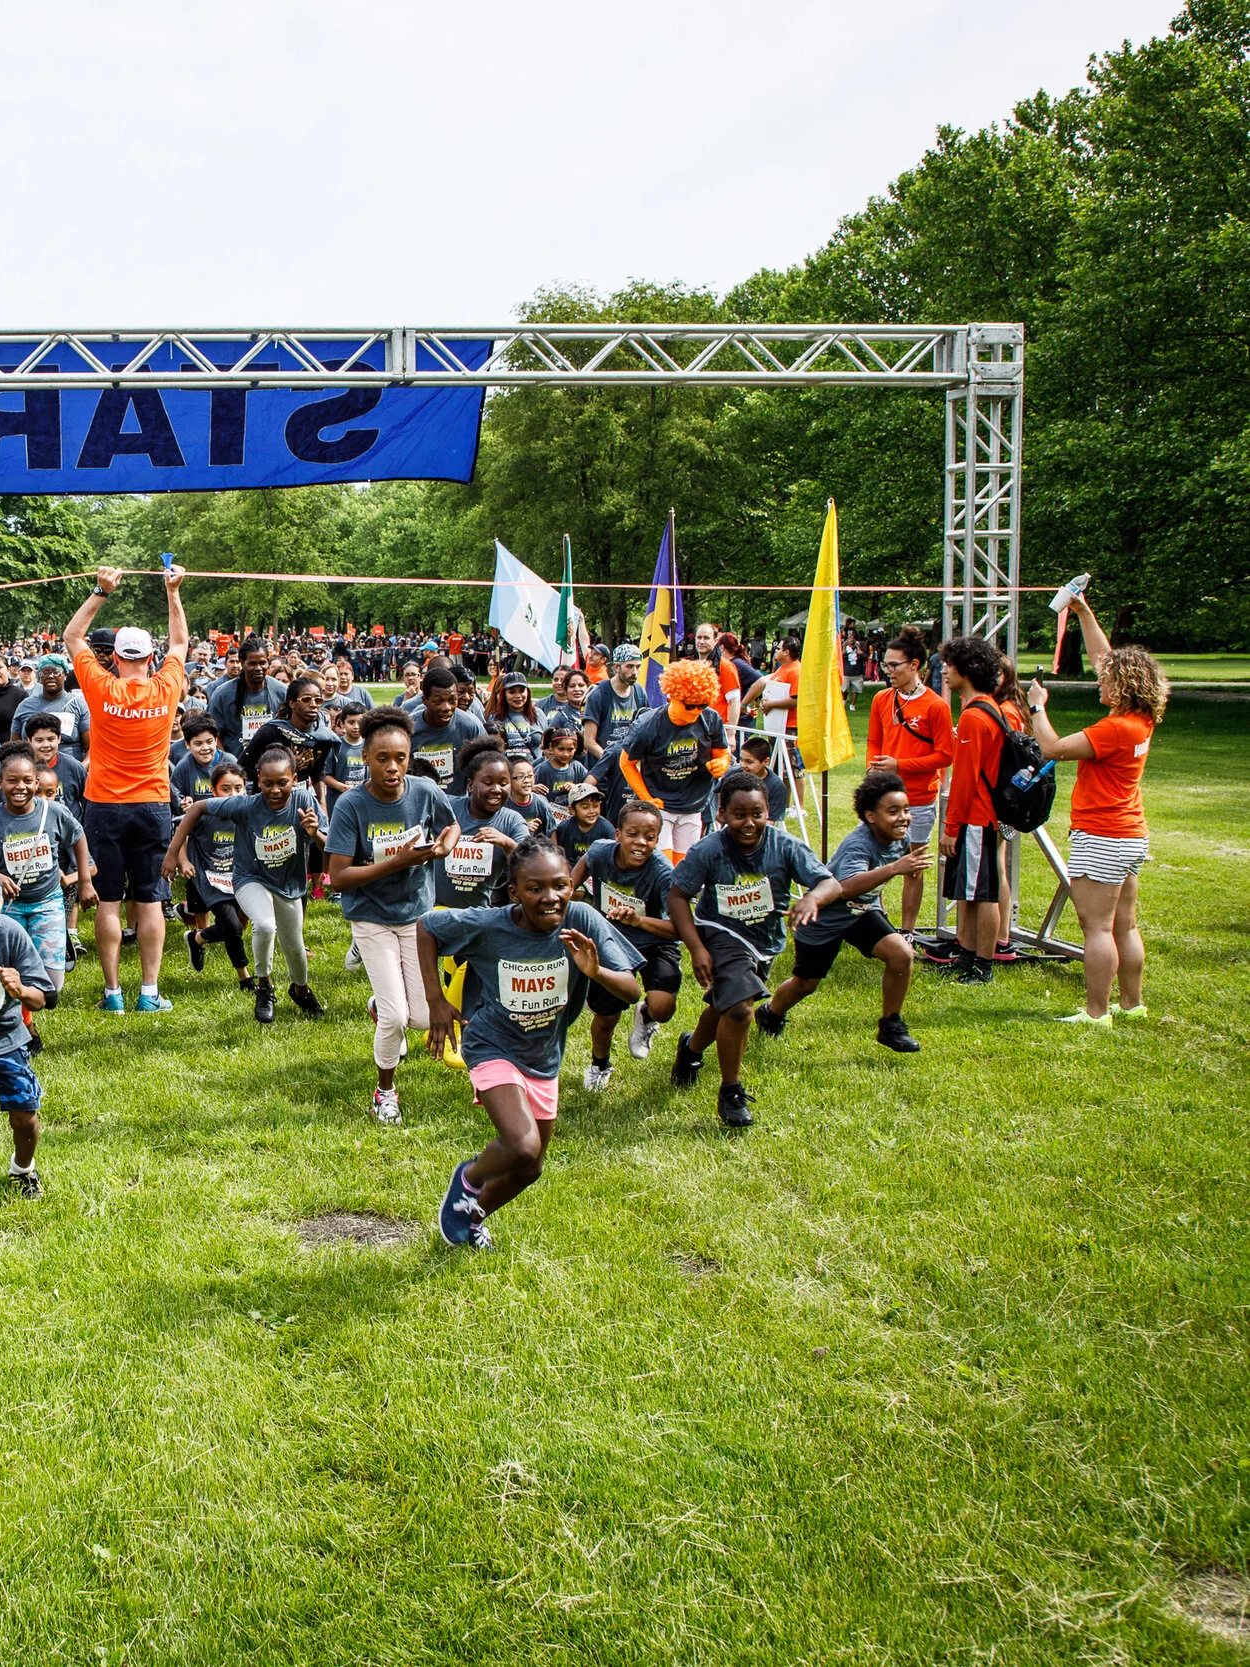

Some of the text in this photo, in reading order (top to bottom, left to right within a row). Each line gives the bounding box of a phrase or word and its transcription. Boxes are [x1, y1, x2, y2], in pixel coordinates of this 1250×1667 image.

[103, 701, 169, 719] VOLUNTEER
[248, 721, 265, 730] MAY
[430, 758, 446, 767] AYS
[376, 834, 407, 843] CHICAGO
[6, 839, 33, 849] CHICAGO
[263, 838, 290, 852] MAYS
[284, 847, 295, 856] Run
[453, 847, 483, 860] MAYS
[35, 862, 48, 870] Run
[459, 864, 486, 874] Fun Run
[719, 879, 767, 892] CHICAGO RUN
[727, 891, 761, 906] MAYS
[752, 904, 768, 913] Run
[502, 959, 565, 972] CHICAGO RUN
[511, 975, 556, 993] MAYS
[522, 996, 560, 1010] Fun Run
[509, 1012, 548, 1021] CHICAGO
